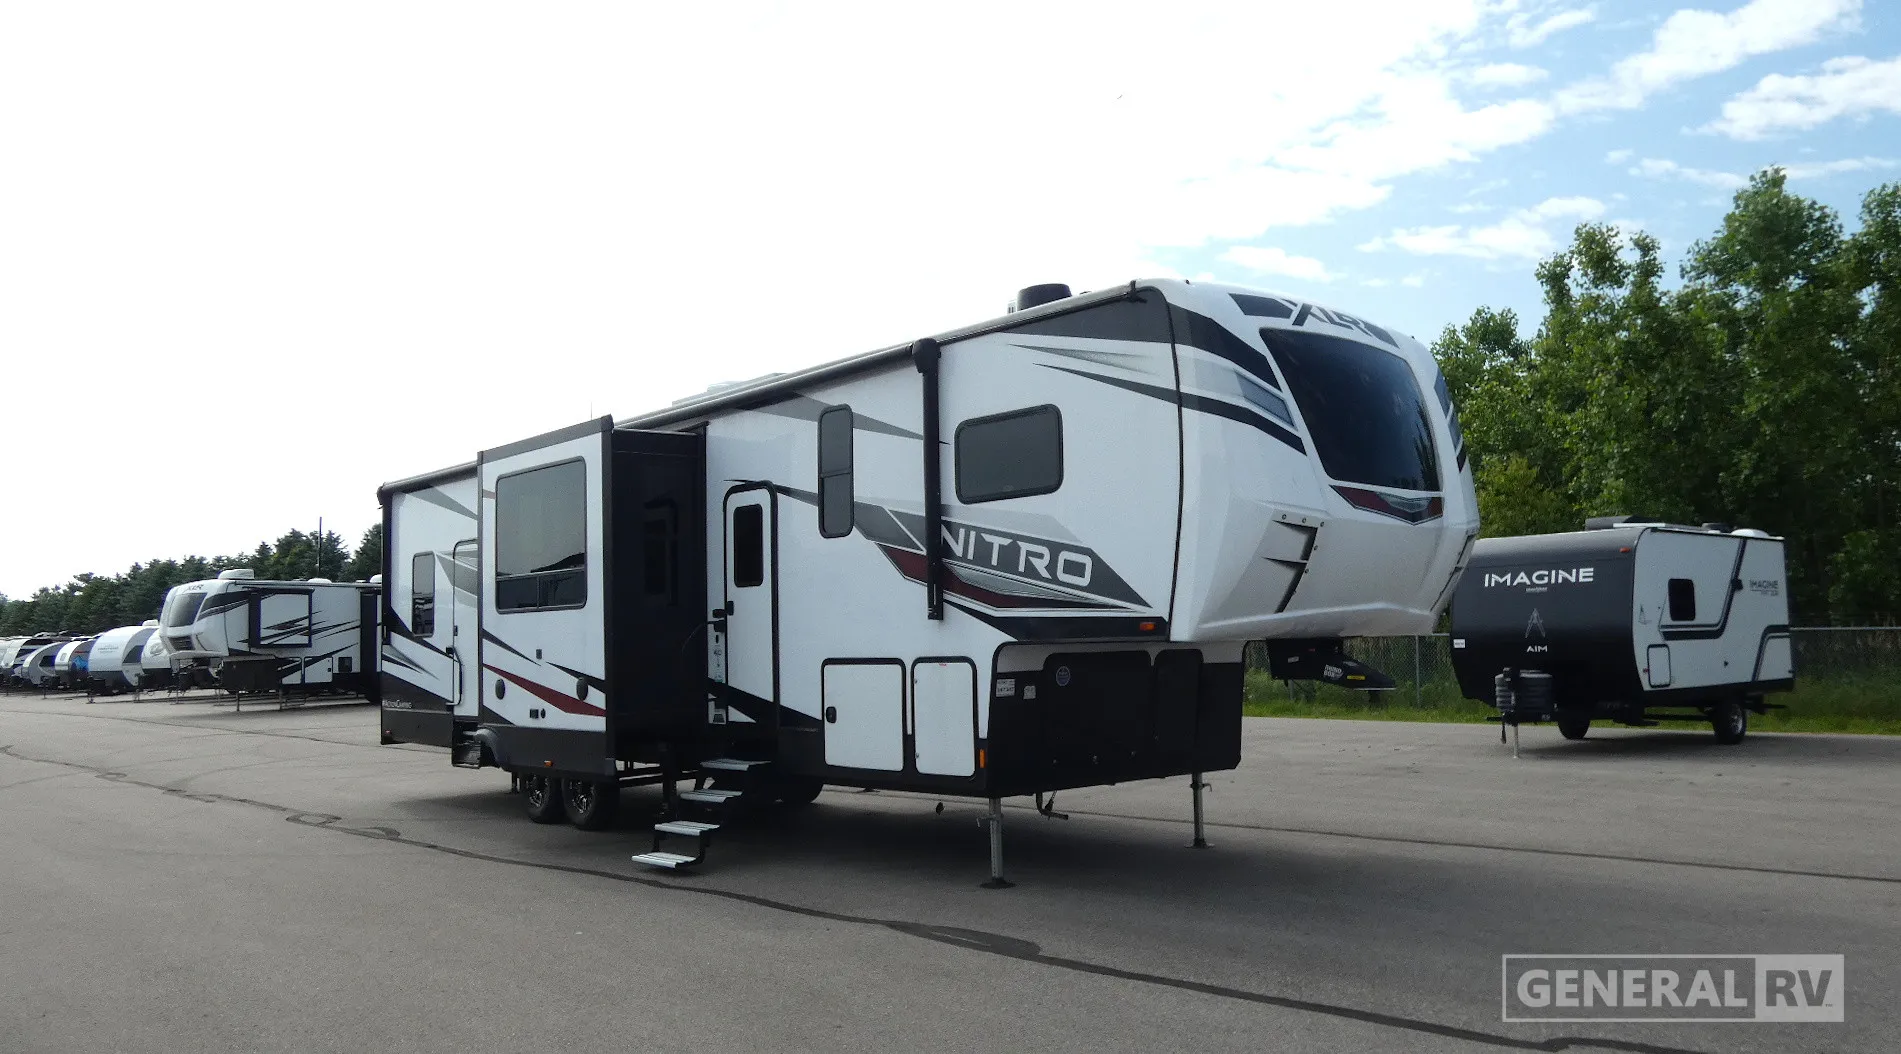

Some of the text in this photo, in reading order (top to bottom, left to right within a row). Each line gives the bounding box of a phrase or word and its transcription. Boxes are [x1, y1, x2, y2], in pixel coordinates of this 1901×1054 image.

[1280, 298, 1373, 338] XLR
[940, 523, 1093, 587] NITRO
[1484, 567, 1595, 588] IMAGINE
[1526, 645, 1548, 653] AIM
